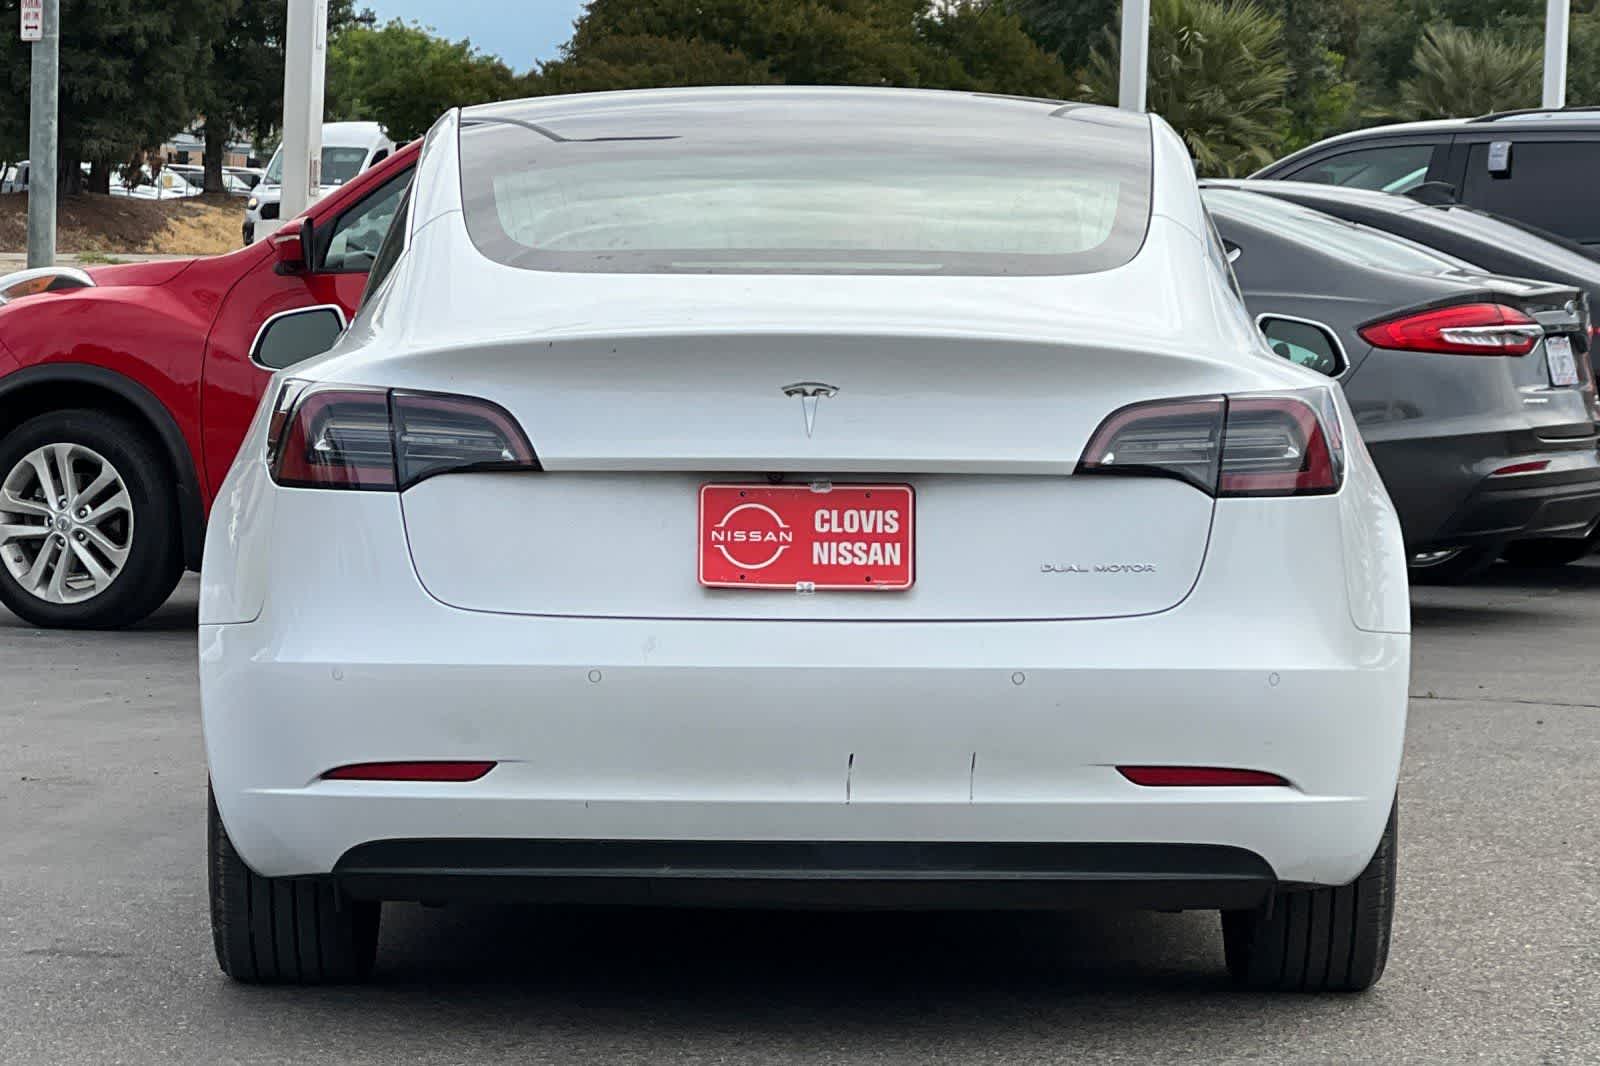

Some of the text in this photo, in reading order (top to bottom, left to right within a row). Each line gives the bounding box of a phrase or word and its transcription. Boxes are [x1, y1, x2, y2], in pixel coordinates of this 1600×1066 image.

[814, 509, 899, 534] CLOVIS
[711, 530, 793, 543] NISSAN
[812, 541, 901, 566] NISSAN
[1040, 563, 1156, 573] DUAL MOTOR
